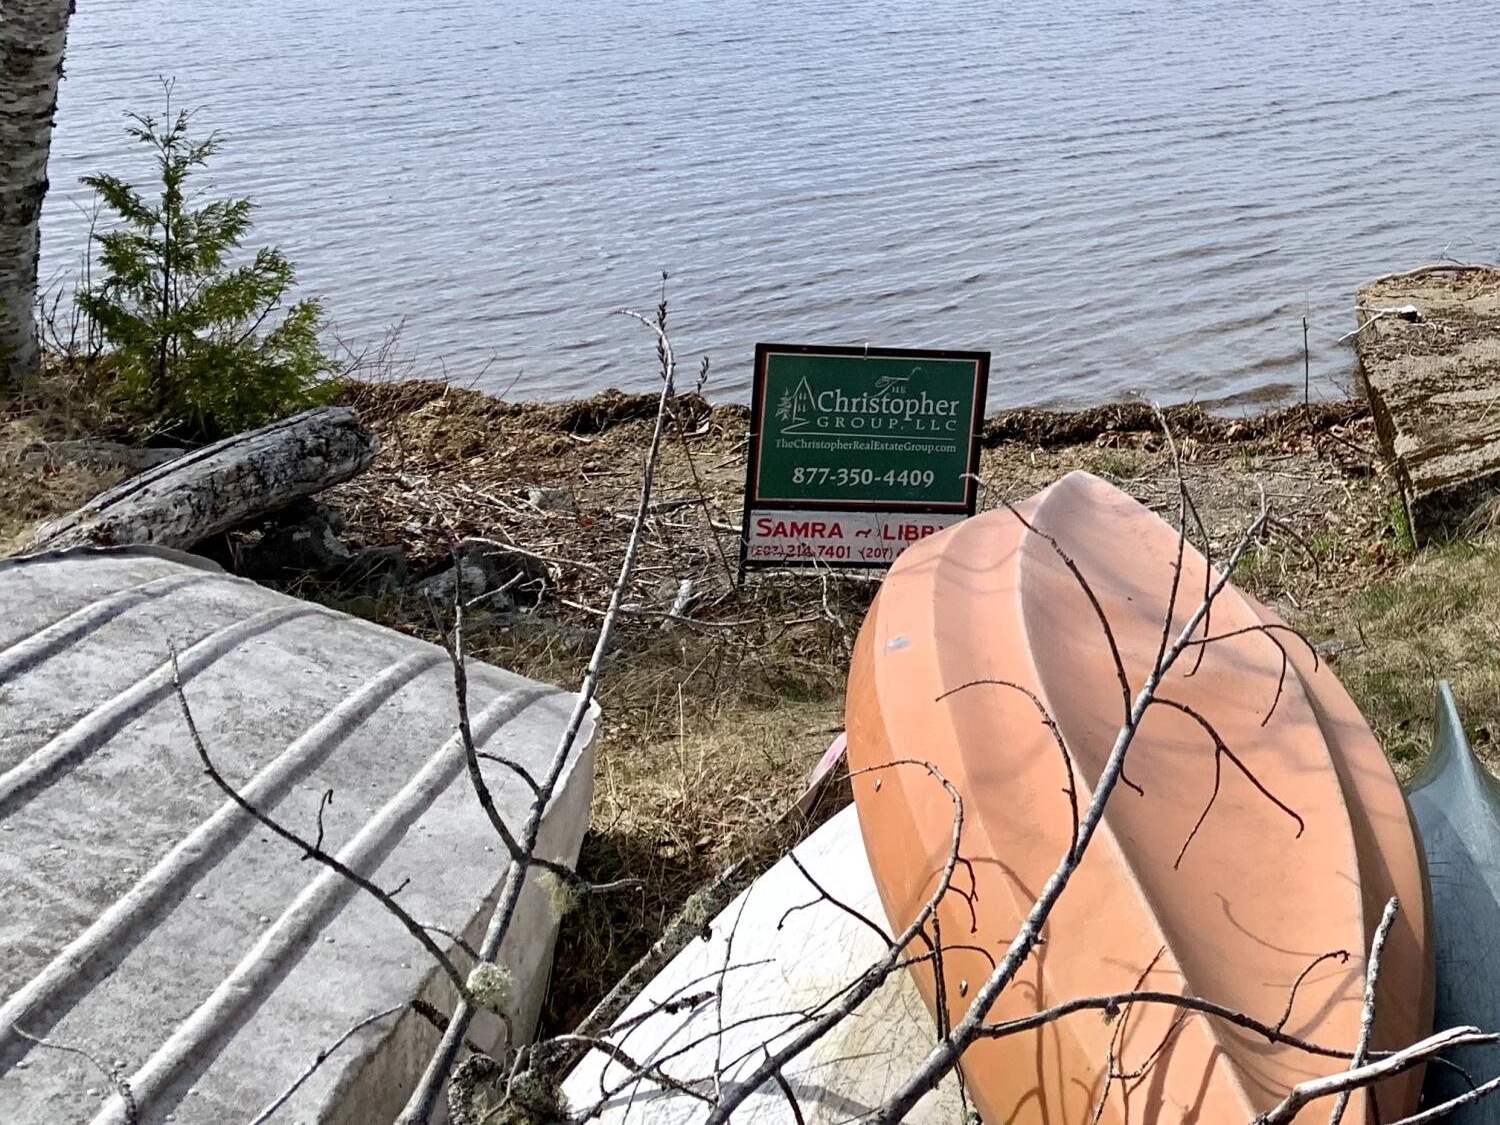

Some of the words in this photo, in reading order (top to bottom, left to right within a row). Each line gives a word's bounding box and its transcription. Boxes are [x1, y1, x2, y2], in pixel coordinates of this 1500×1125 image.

[817, 388, 960, 421] Christopher
[915, 419, 957, 431] LLC
[776, 438, 957, 454] TheChristopherRealEstateGroup.com
[792, 466, 935, 488] 877-350-4409
[756, 518, 845, 539] SAMRA
[817, 545, 851, 559] 7401
[862, 547, 893, 560] (207)
